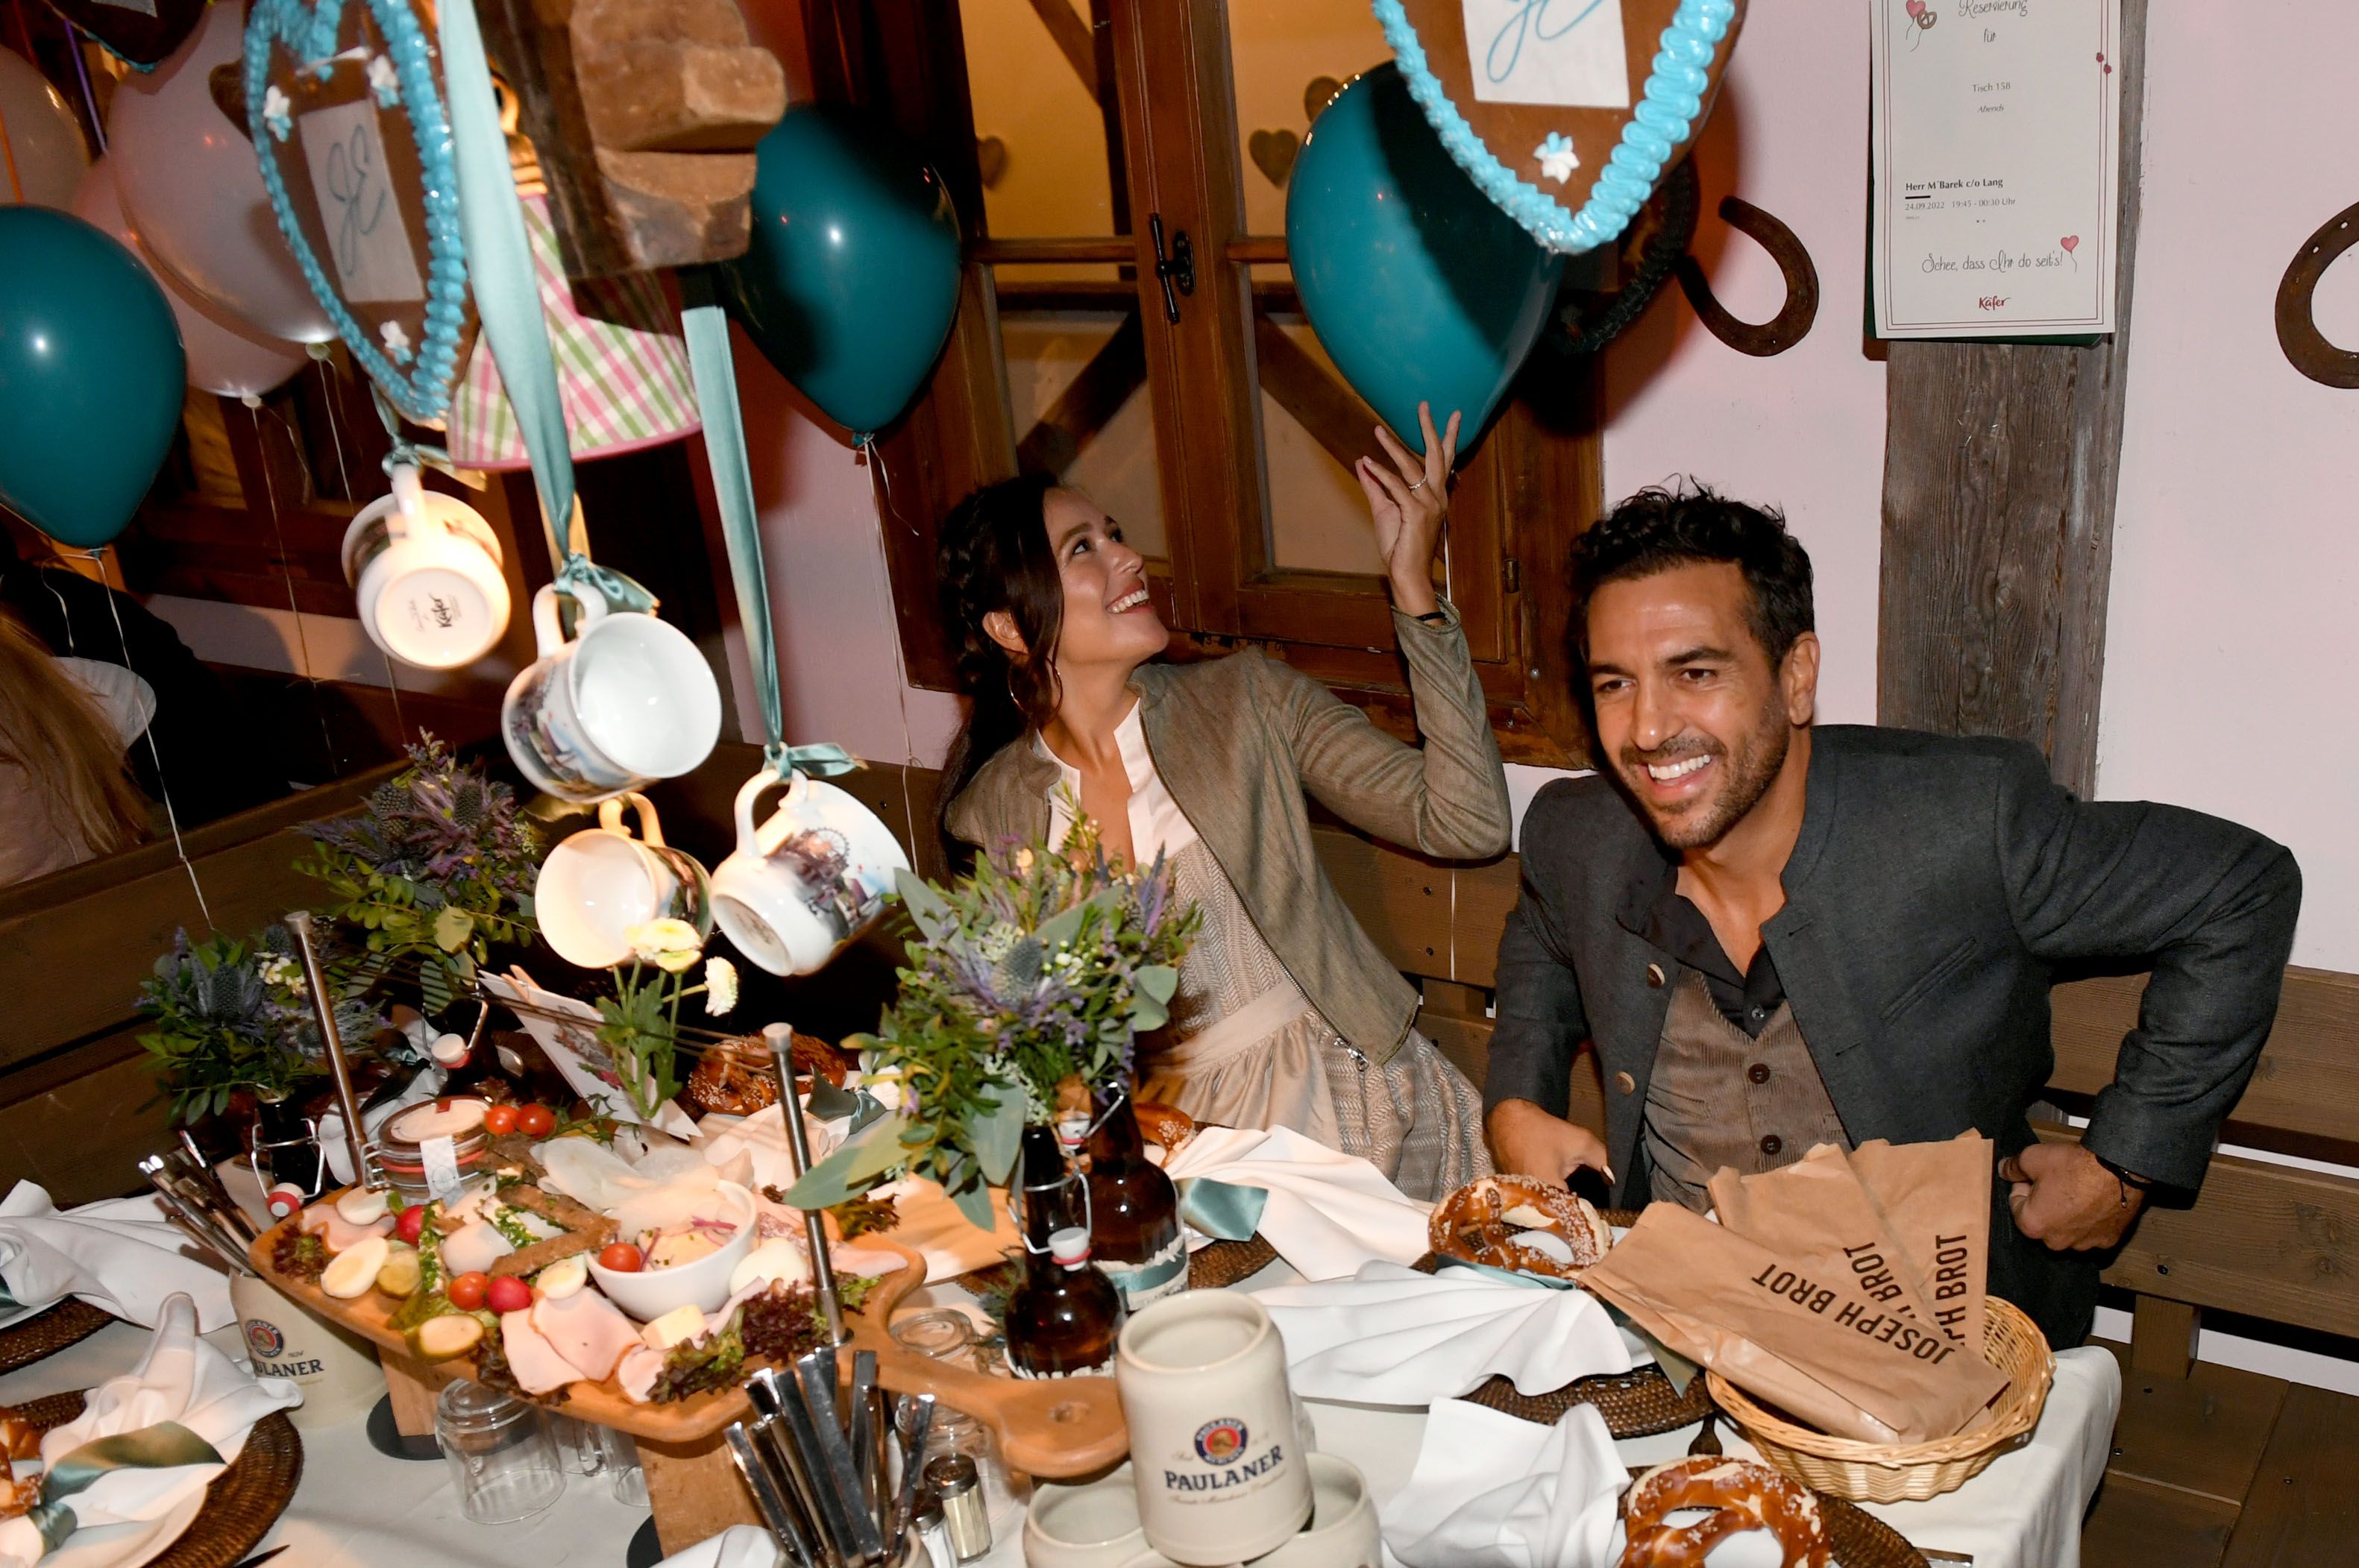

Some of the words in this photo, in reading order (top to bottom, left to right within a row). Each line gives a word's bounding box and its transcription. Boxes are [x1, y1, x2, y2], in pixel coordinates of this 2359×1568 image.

[1973, 83, 1993, 92] Tisch
[1906, 182, 1926, 191] Herr
[1966, 179, 1980, 188] c/o
[1983, 178, 2003, 188] Lang
[1905, 201, 1945, 211] 24.09.2022
[1952, 200, 1972, 209] 19:45
[1979, 198, 2000, 207] 00:30
[2002, 198, 2016, 206] Uhr
[1922, 254, 1958, 273] Schee,
[1962, 255, 1985, 270] dass
[2018, 252, 2032, 268] do
[1979, 295, 2011, 310] Käfer
[1842, 1242, 1903, 1303] BROT
[1935, 1235, 1967, 1300] BROT
[1751, 1264, 1836, 1314] BROT
[1834, 1302, 1956, 1364] JOSEPH
[254, 1358, 324, 1377] ULANER
[1164, 1445, 1283, 1490] PAULANER
